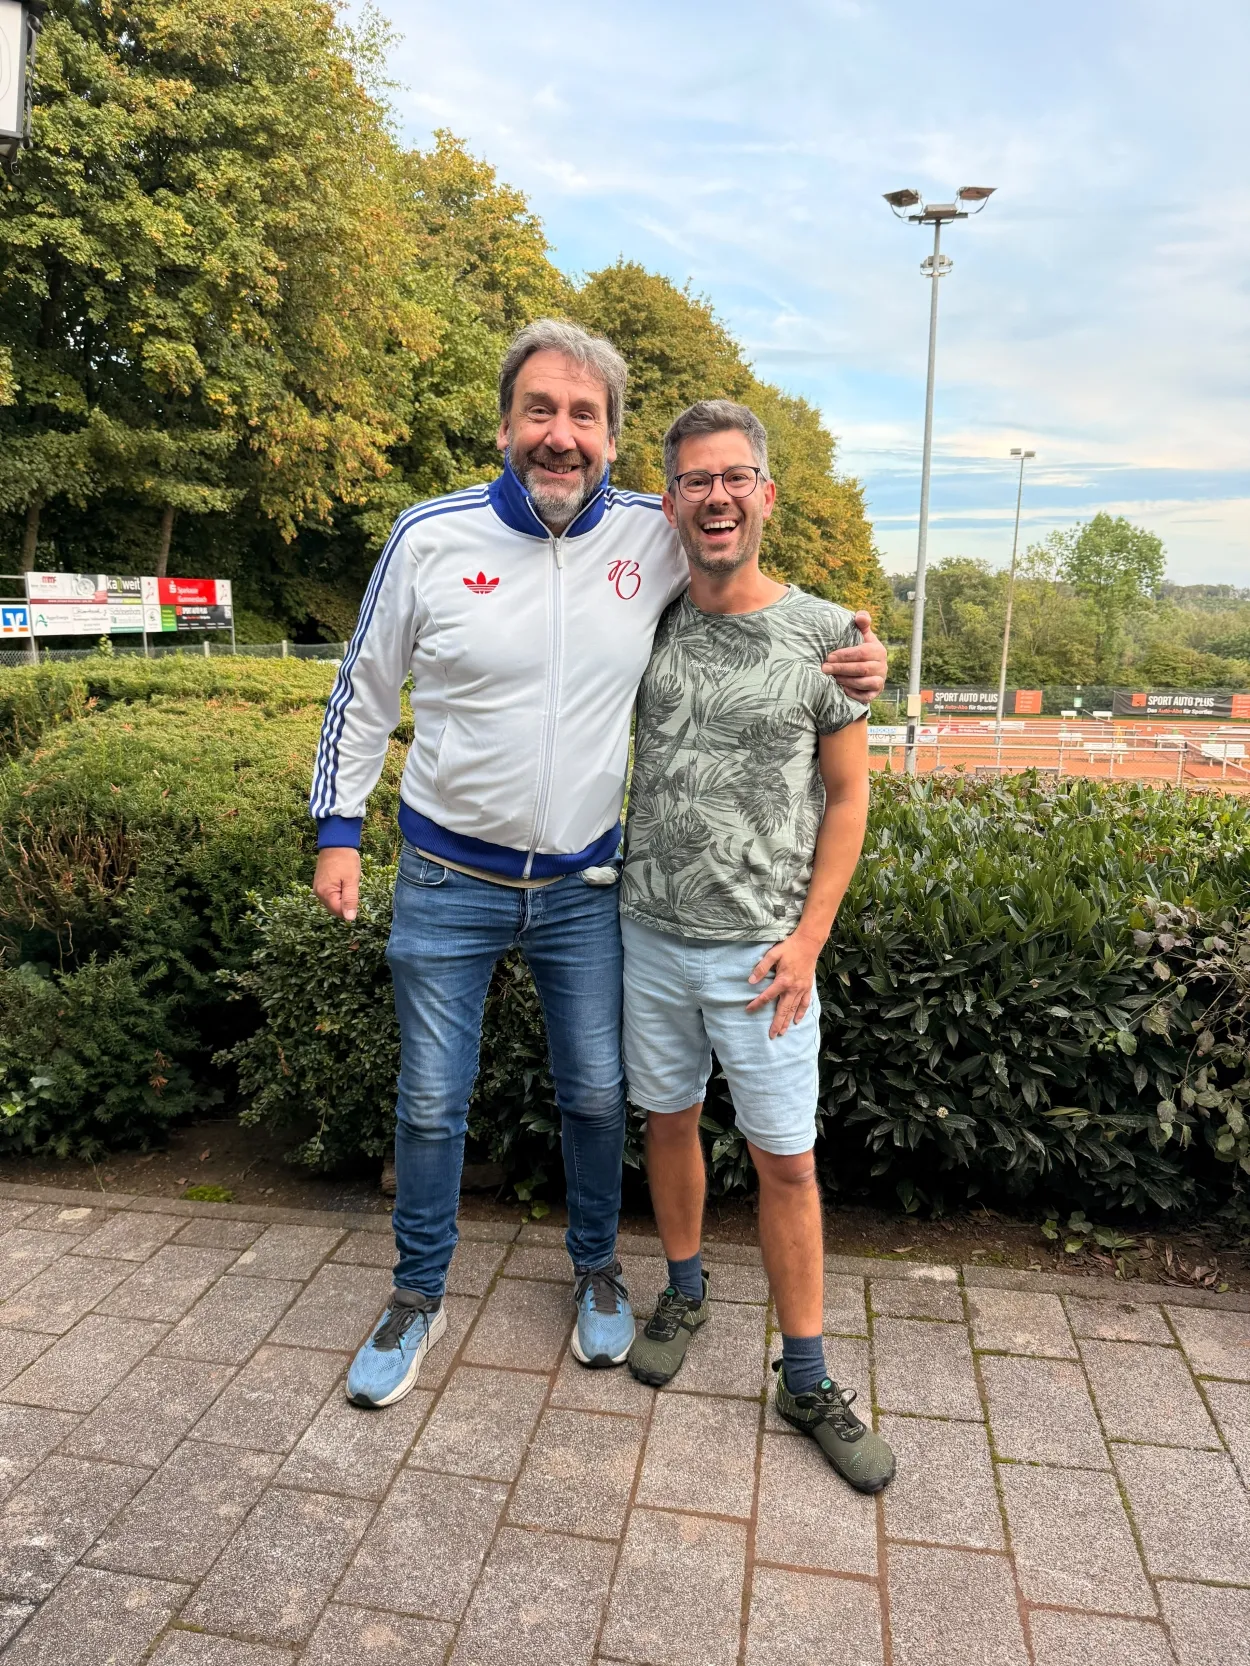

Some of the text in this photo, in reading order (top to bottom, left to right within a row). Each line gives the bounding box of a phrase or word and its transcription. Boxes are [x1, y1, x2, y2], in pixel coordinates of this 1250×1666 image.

[934, 692, 999, 703] SPORT AUTO PLUS
[1148, 695, 1215, 707] SPORT AUTO PLUS
[976, 704, 998, 713] Sportler
[1191, 708, 1213, 716] Sportler
